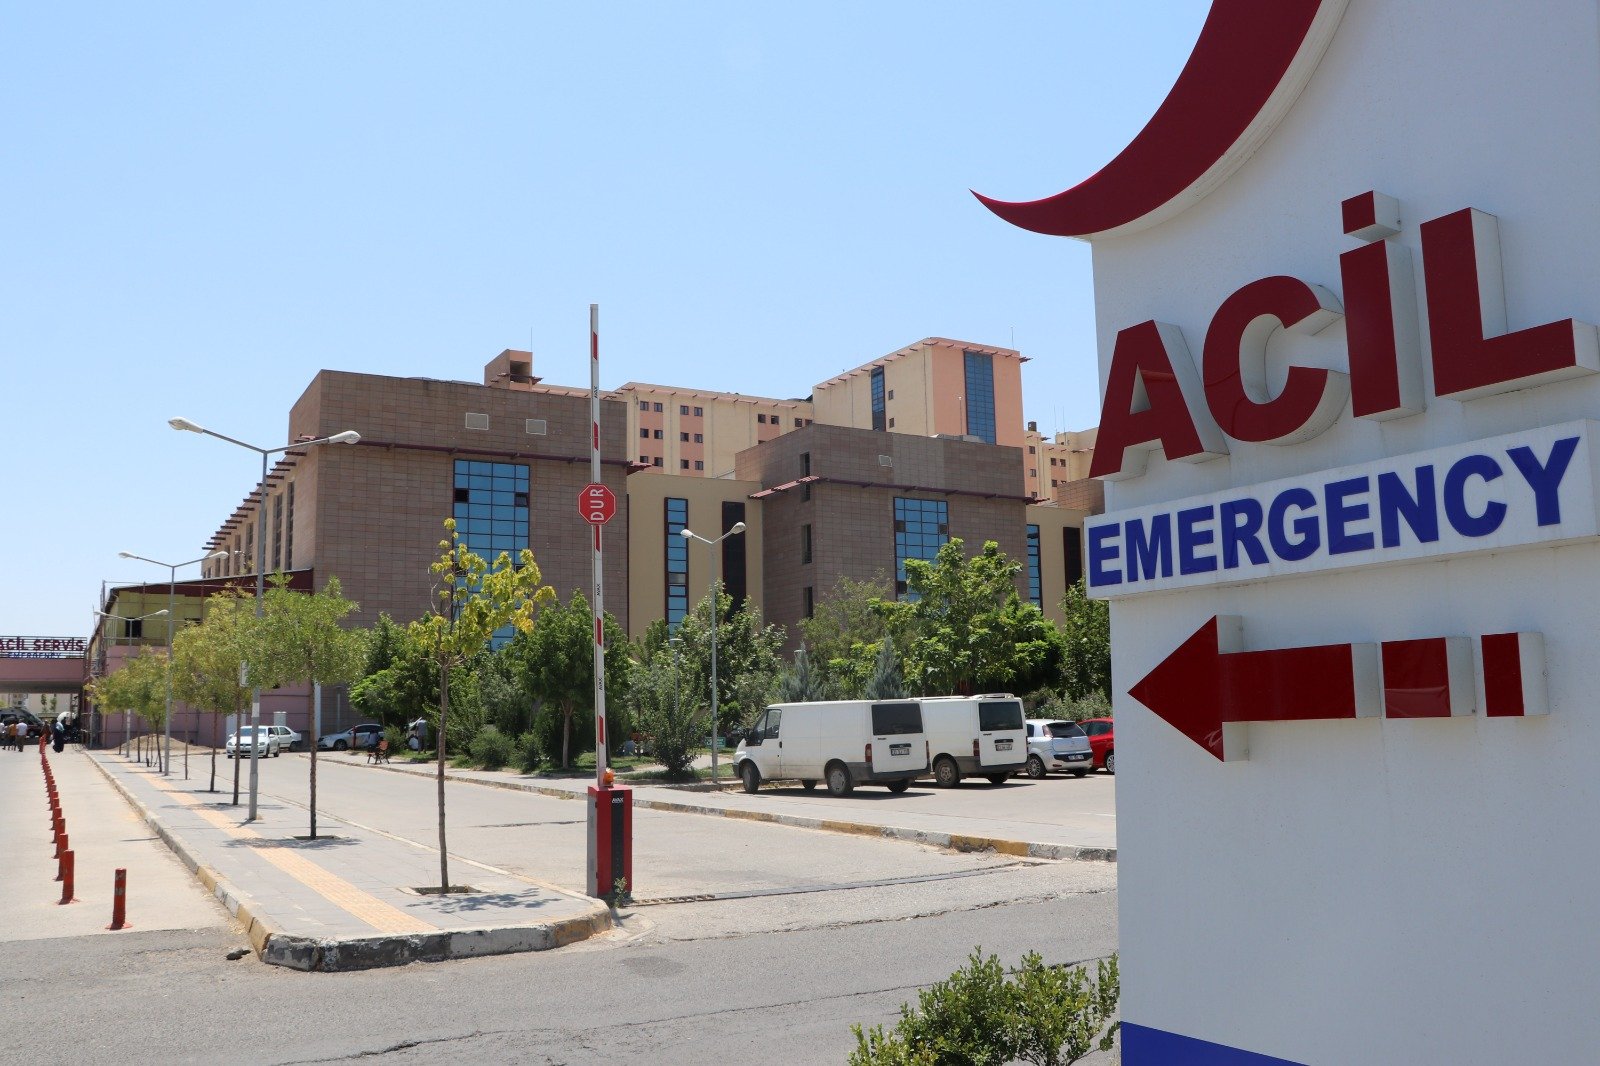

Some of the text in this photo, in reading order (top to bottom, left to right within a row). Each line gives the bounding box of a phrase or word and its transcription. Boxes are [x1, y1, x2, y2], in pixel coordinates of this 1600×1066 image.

[1088, 190, 1577, 478] ACİL
[590, 489, 605, 521] DUR
[1088, 436, 1581, 588] EMERGENCY
[34, 637, 84, 651] SERVİS
